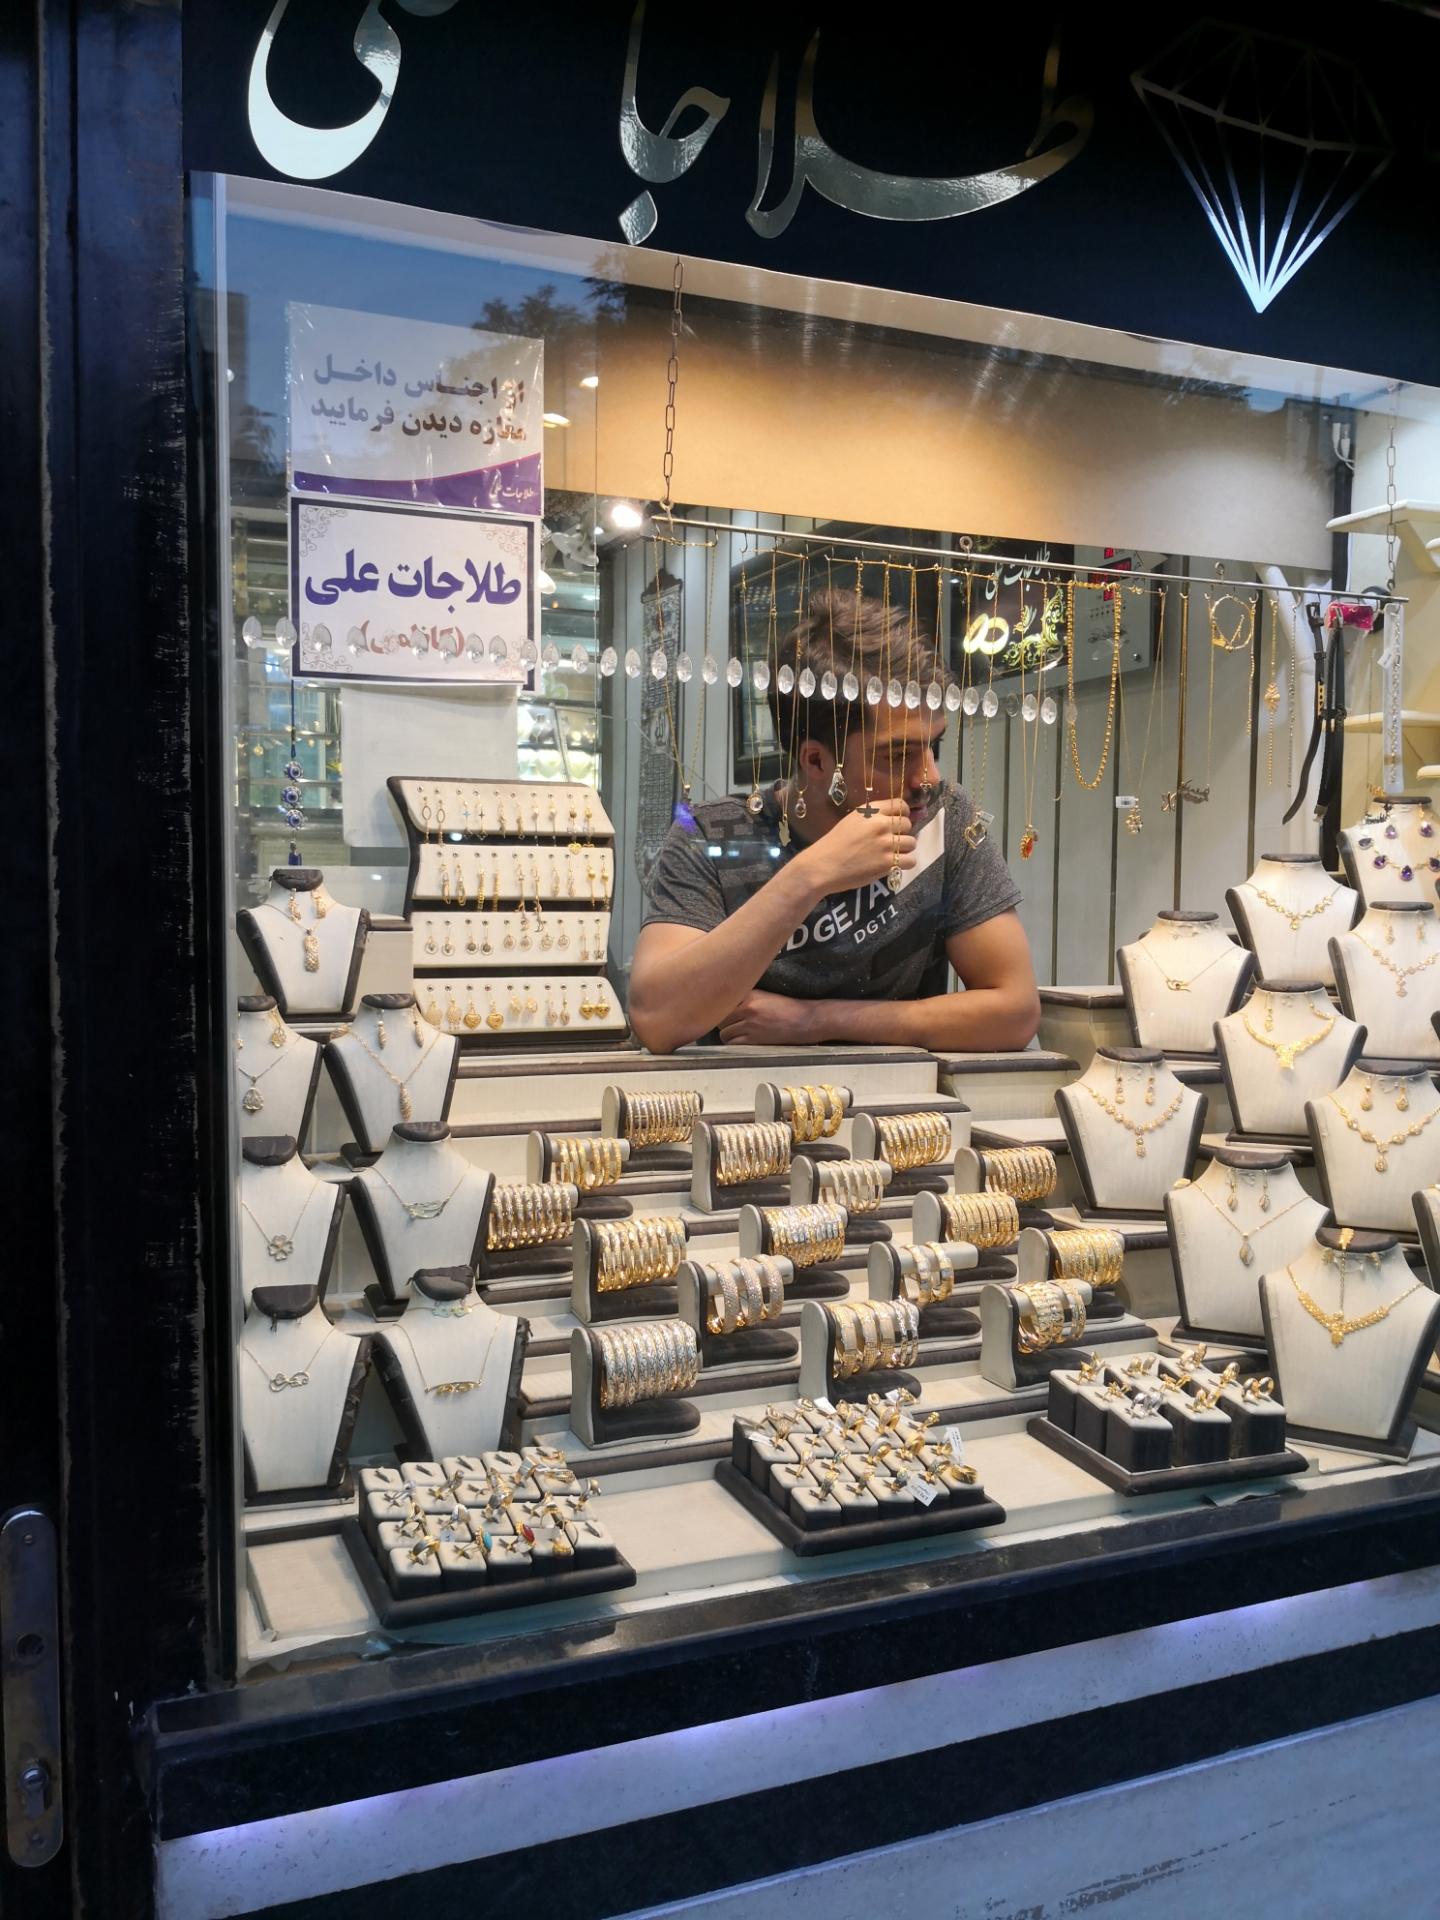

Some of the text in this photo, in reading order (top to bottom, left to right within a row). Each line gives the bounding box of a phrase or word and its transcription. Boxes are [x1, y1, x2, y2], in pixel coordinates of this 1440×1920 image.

[313, 353, 397, 387] داخل
[404, 369, 497, 405] اجناس
[401, 411, 463, 440] دیدن
[304, 548, 523, 614] طلاجات علی
[853, 903, 899, 945] DGT1
